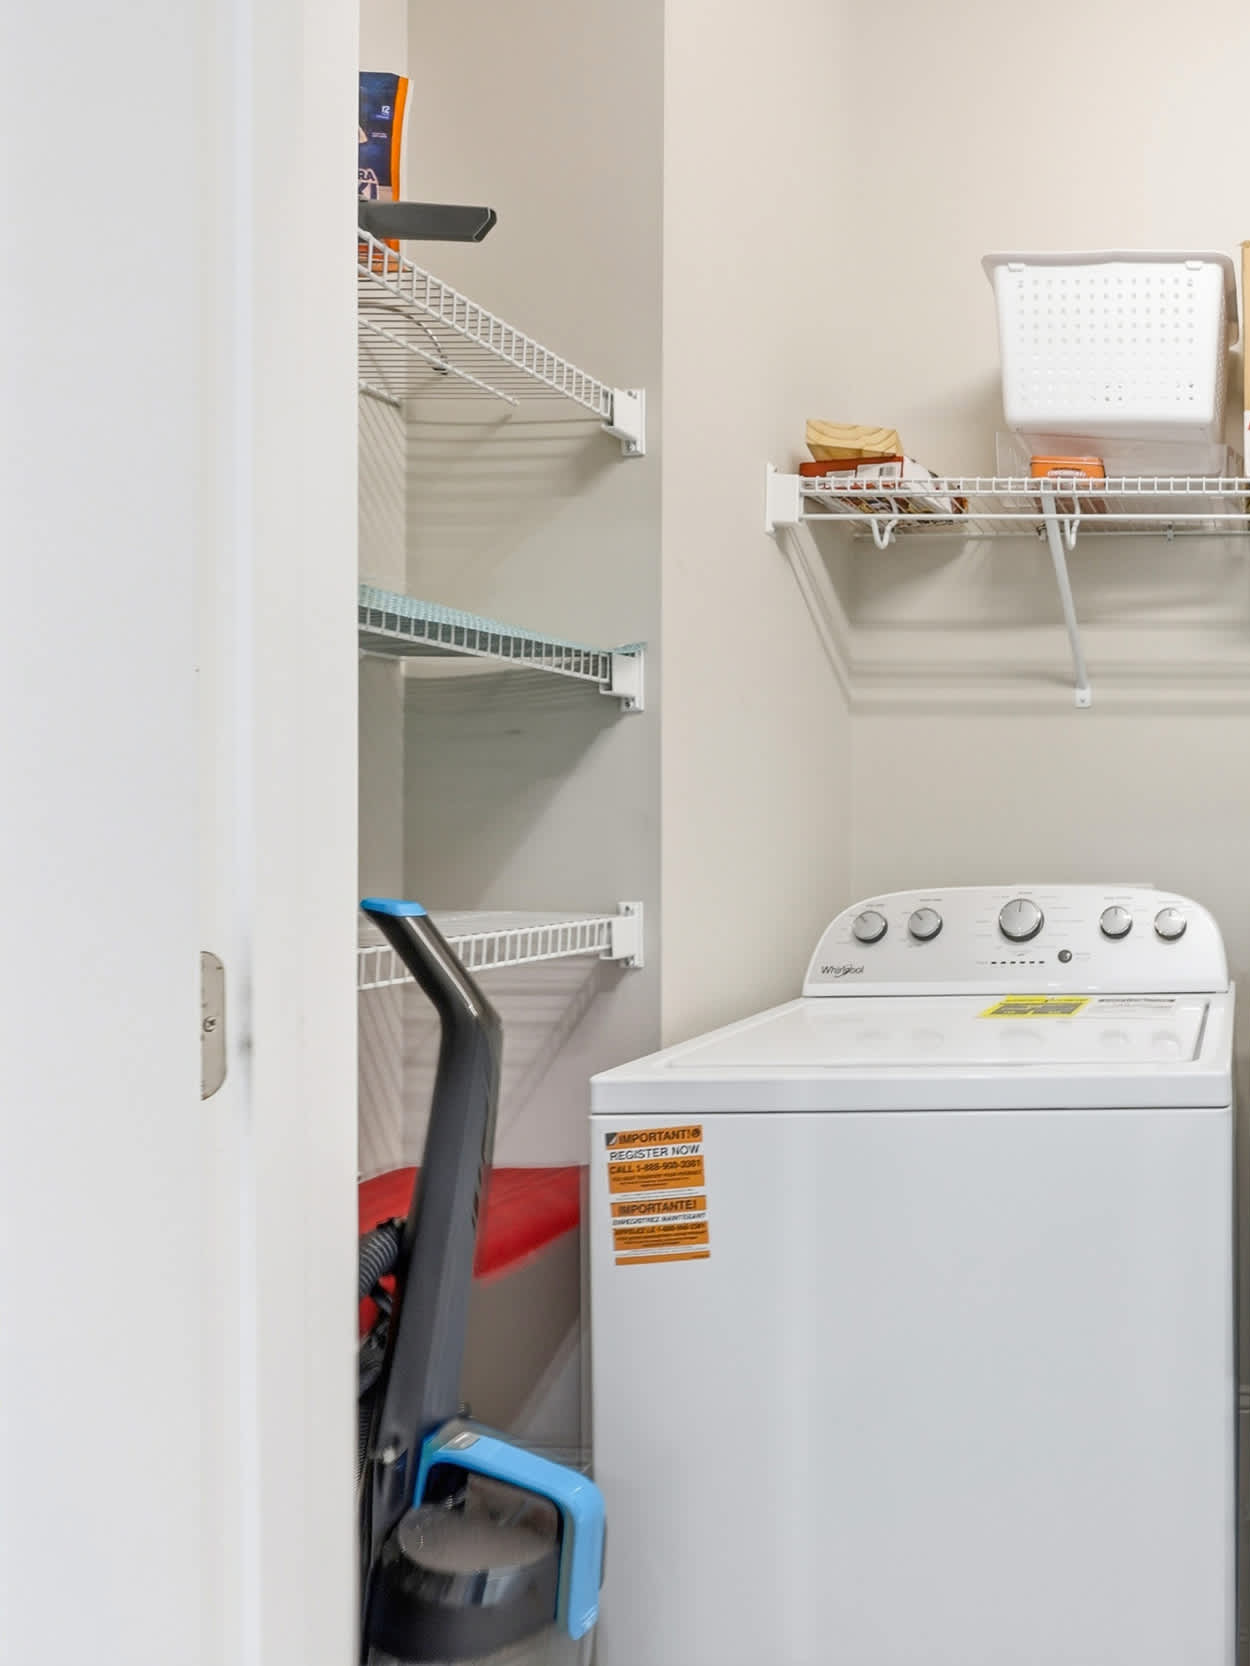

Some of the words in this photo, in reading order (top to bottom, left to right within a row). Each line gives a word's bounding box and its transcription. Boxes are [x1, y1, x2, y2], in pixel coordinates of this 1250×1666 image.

[820, 964, 864, 978] Whirlpool
[618, 1129, 692, 1144] IMPORTANT!
[609, 1147, 669, 1161] REGISTER
[671, 1144, 701, 1156] NOW
[610, 1164, 634, 1174] CALL
